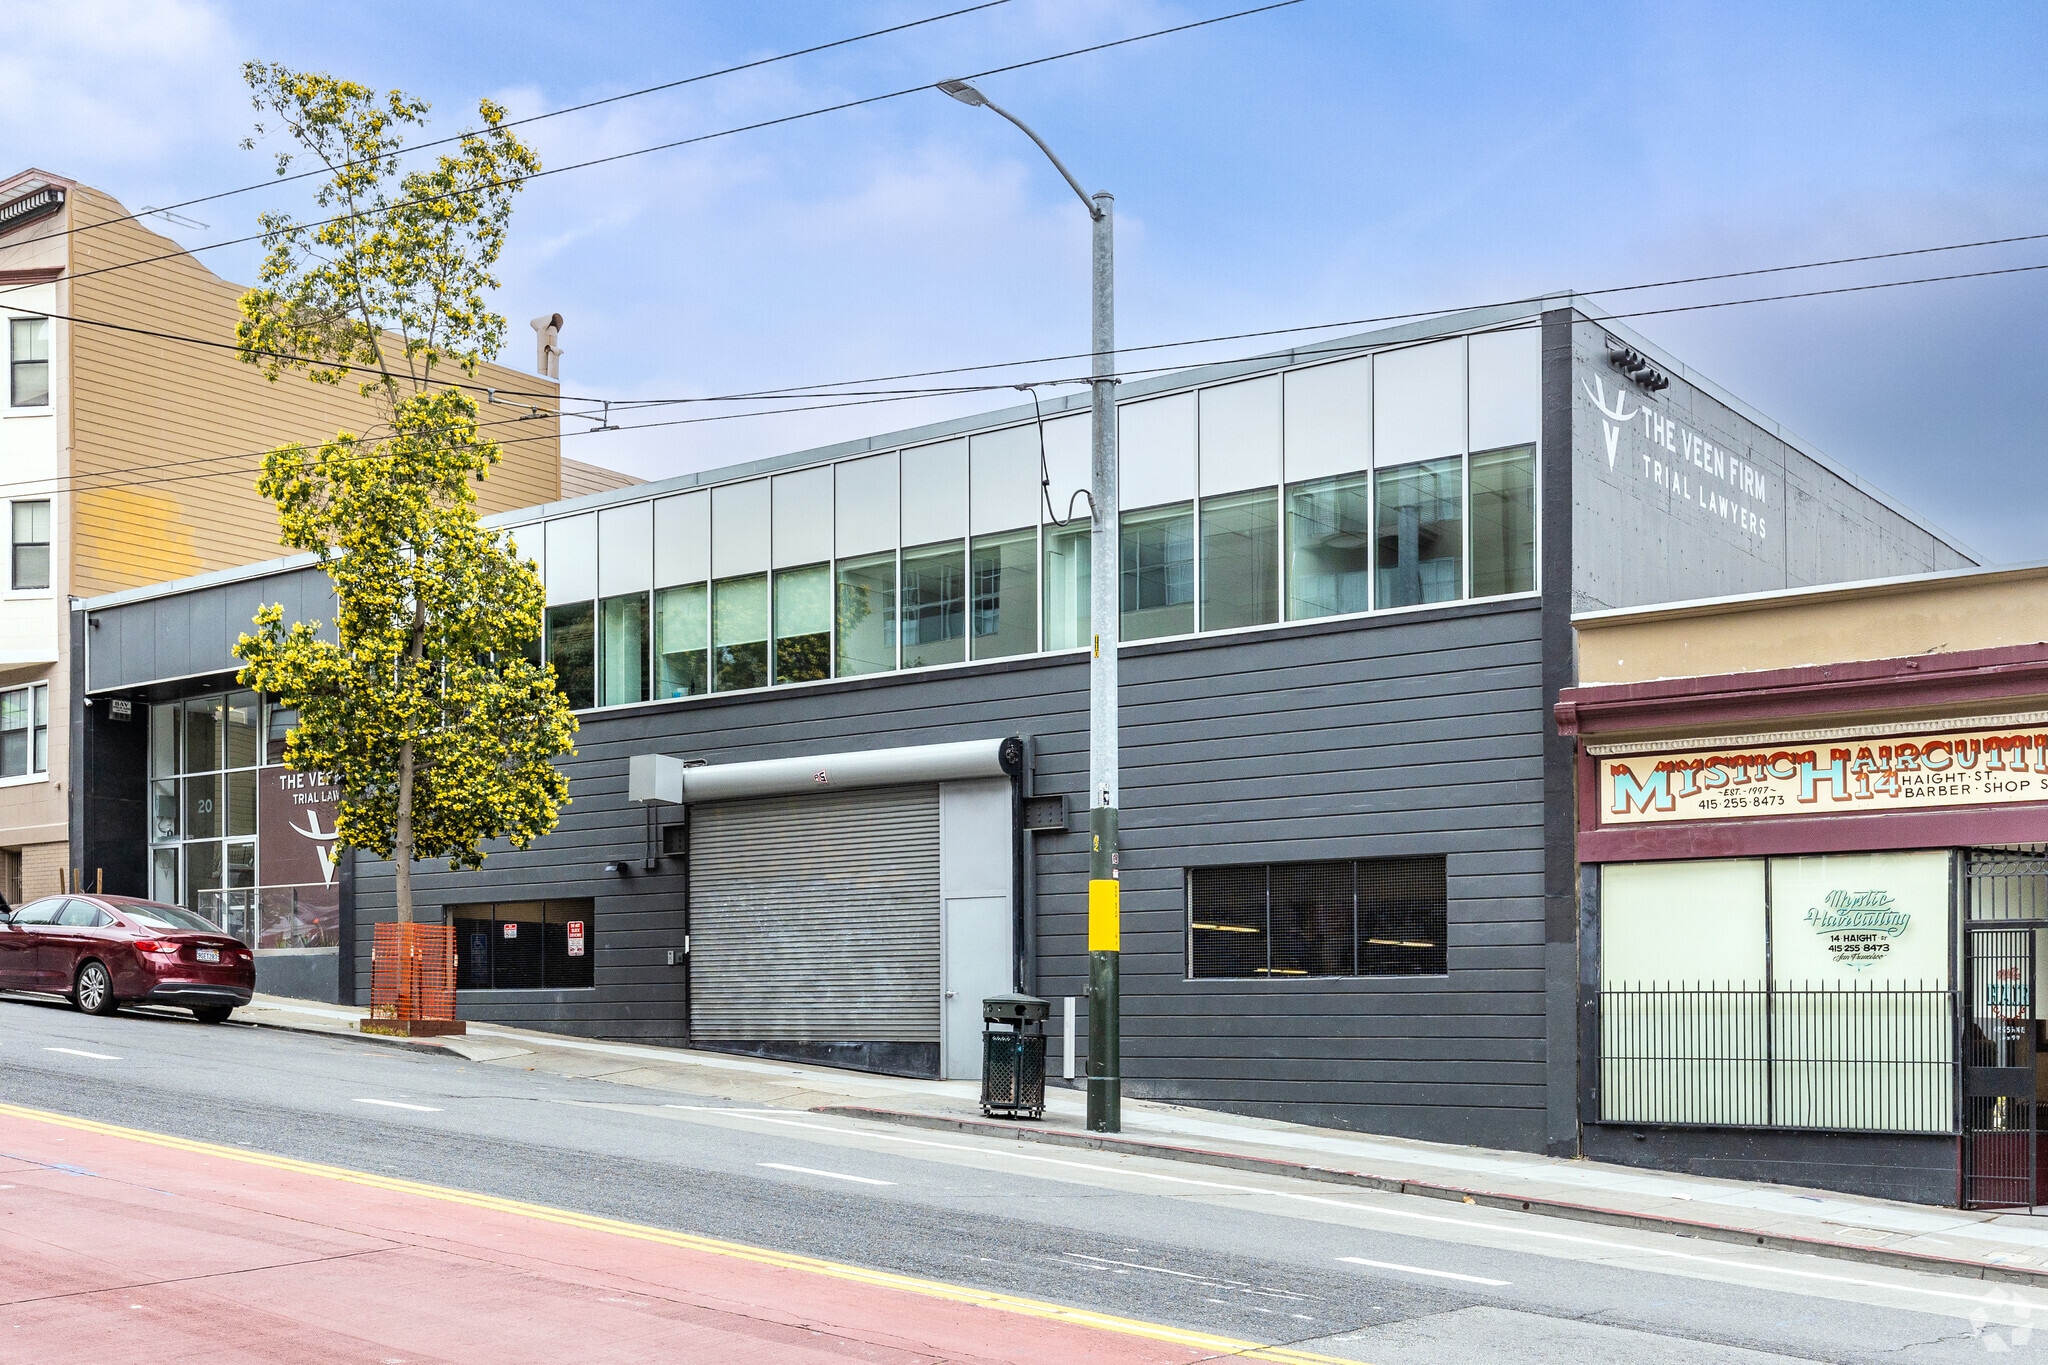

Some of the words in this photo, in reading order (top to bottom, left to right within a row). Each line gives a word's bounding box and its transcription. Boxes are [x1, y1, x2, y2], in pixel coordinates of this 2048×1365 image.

[1642, 405, 1676, 453] THE
[1681, 428, 1725, 480] VEEN
[1729, 456, 1766, 503] FIRM
[1642, 454, 1690, 500] TRIAL
[1699, 485, 1766, 539] LAWYERS
[279, 773, 305, 790] THE
[1610, 750, 1797, 814] MYSTIC
[1854, 771, 1902, 799] 14
[1901, 773, 1967, 786] HAIGHT
[1904, 784, 1971, 798] BARBER
[1983, 780, 2031, 794] SHOP
[292, 792, 320, 805] TRIAL
[1747, 786, 1769, 795] 1997
[198, 798, 213, 813] 20
[1830, 934, 1841, 942] 14
[1843, 934, 1878, 942] HAIGHT
